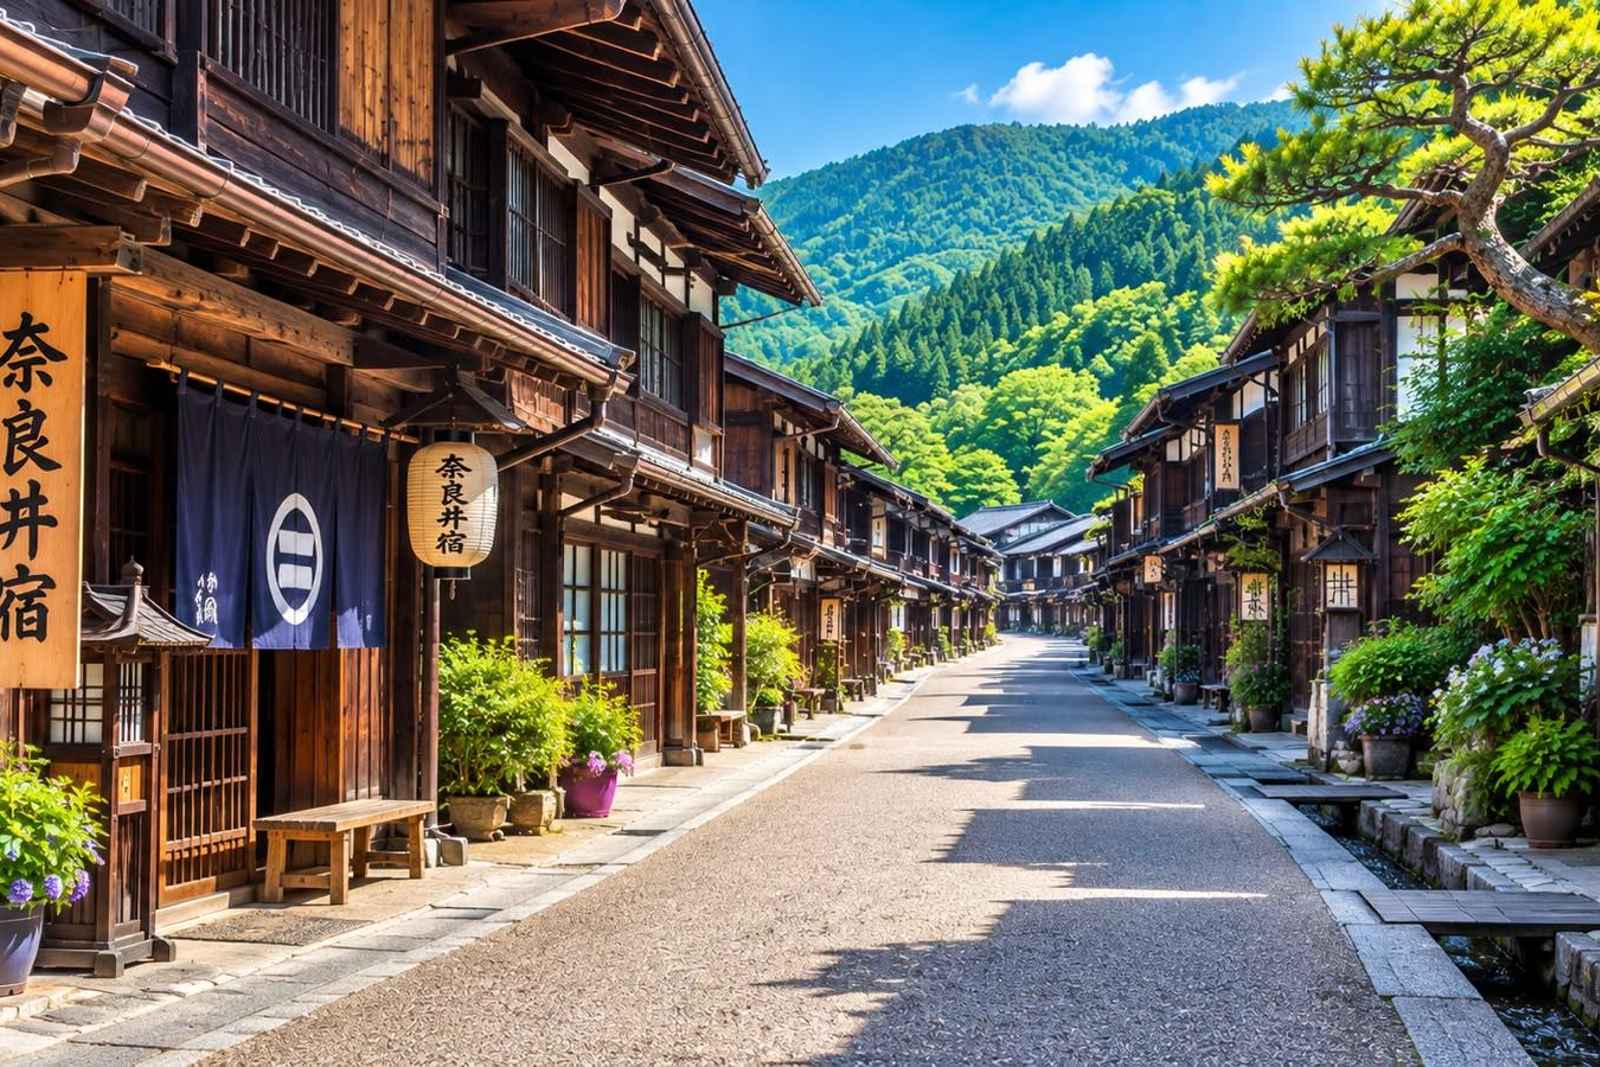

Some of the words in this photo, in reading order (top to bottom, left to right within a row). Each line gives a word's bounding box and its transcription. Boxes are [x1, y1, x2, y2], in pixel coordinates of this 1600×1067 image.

[0, 312, 68, 642] 奈良井宿
[435, 454, 472, 555] 奈良井宿
